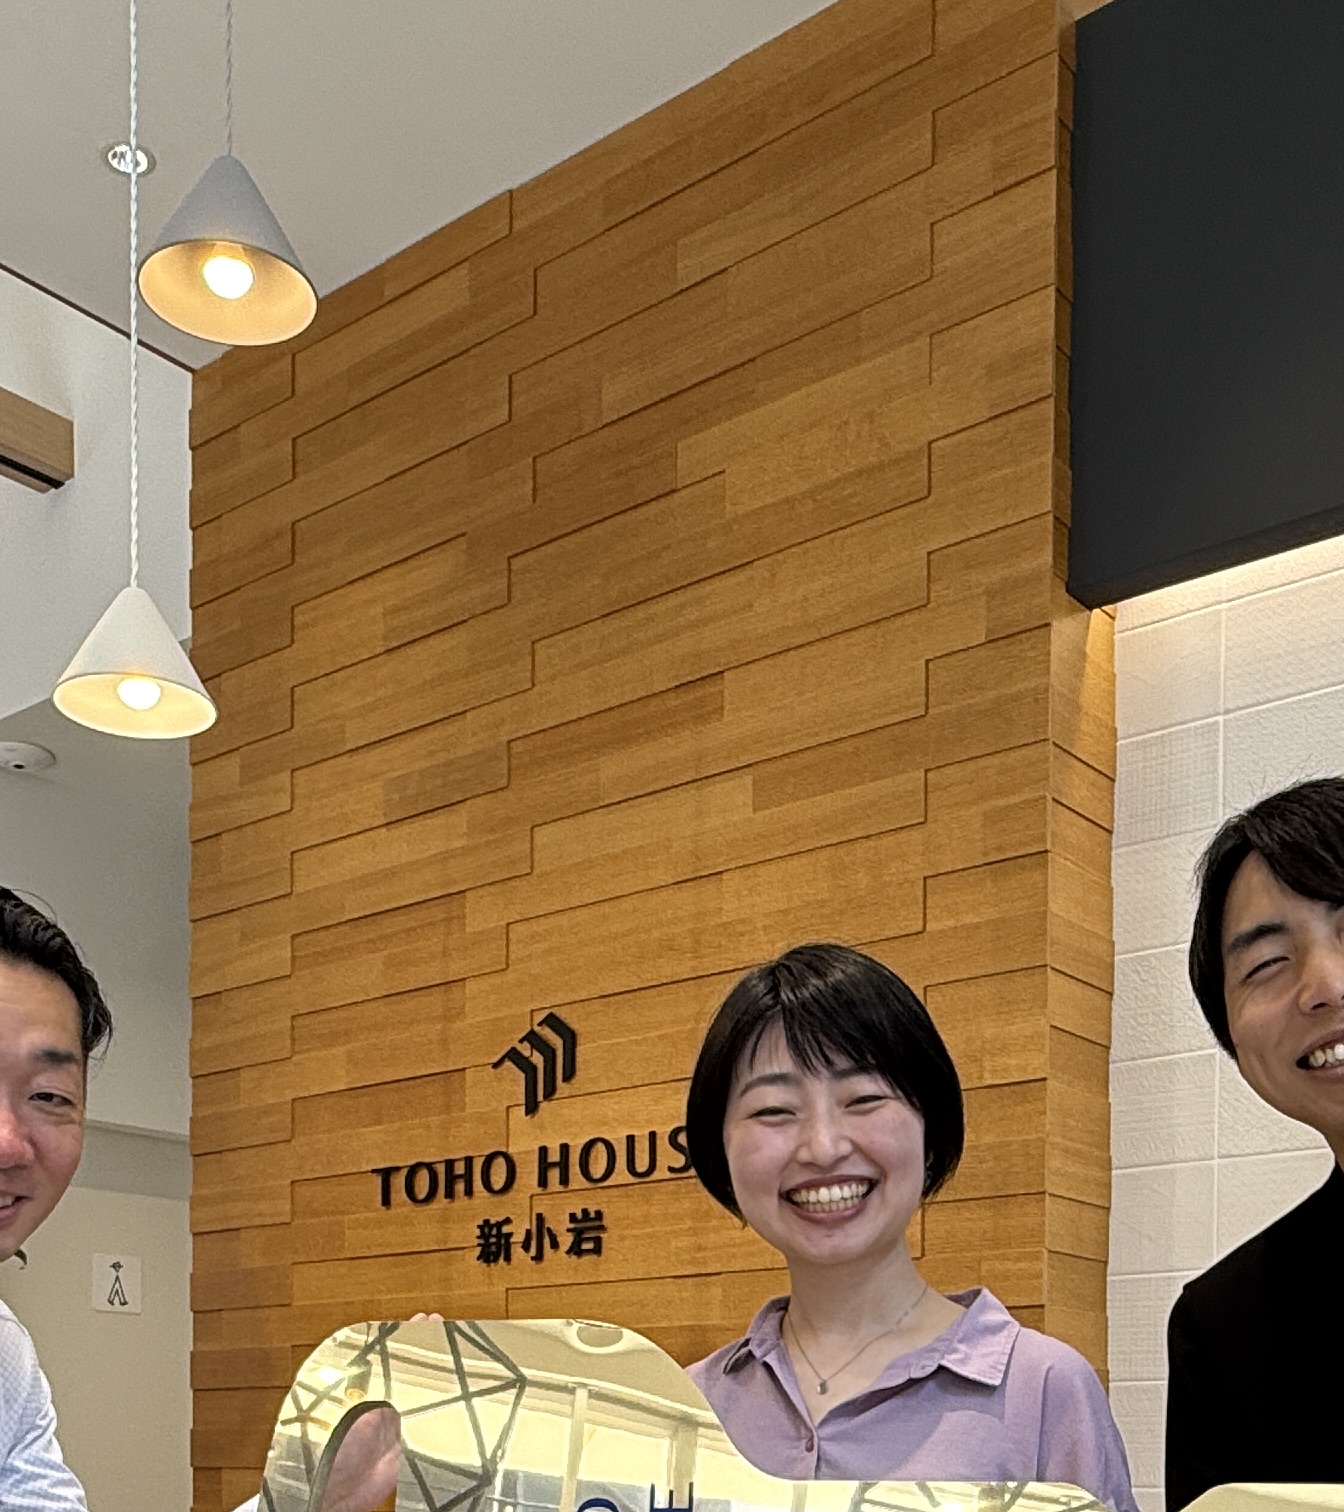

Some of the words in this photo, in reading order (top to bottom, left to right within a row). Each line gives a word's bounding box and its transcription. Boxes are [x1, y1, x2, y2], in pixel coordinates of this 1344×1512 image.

[371, 1150, 517, 1208] TOHO
[536, 1125, 692, 1189] HOUS
[475, 1207, 607, 1265] 新小岩
